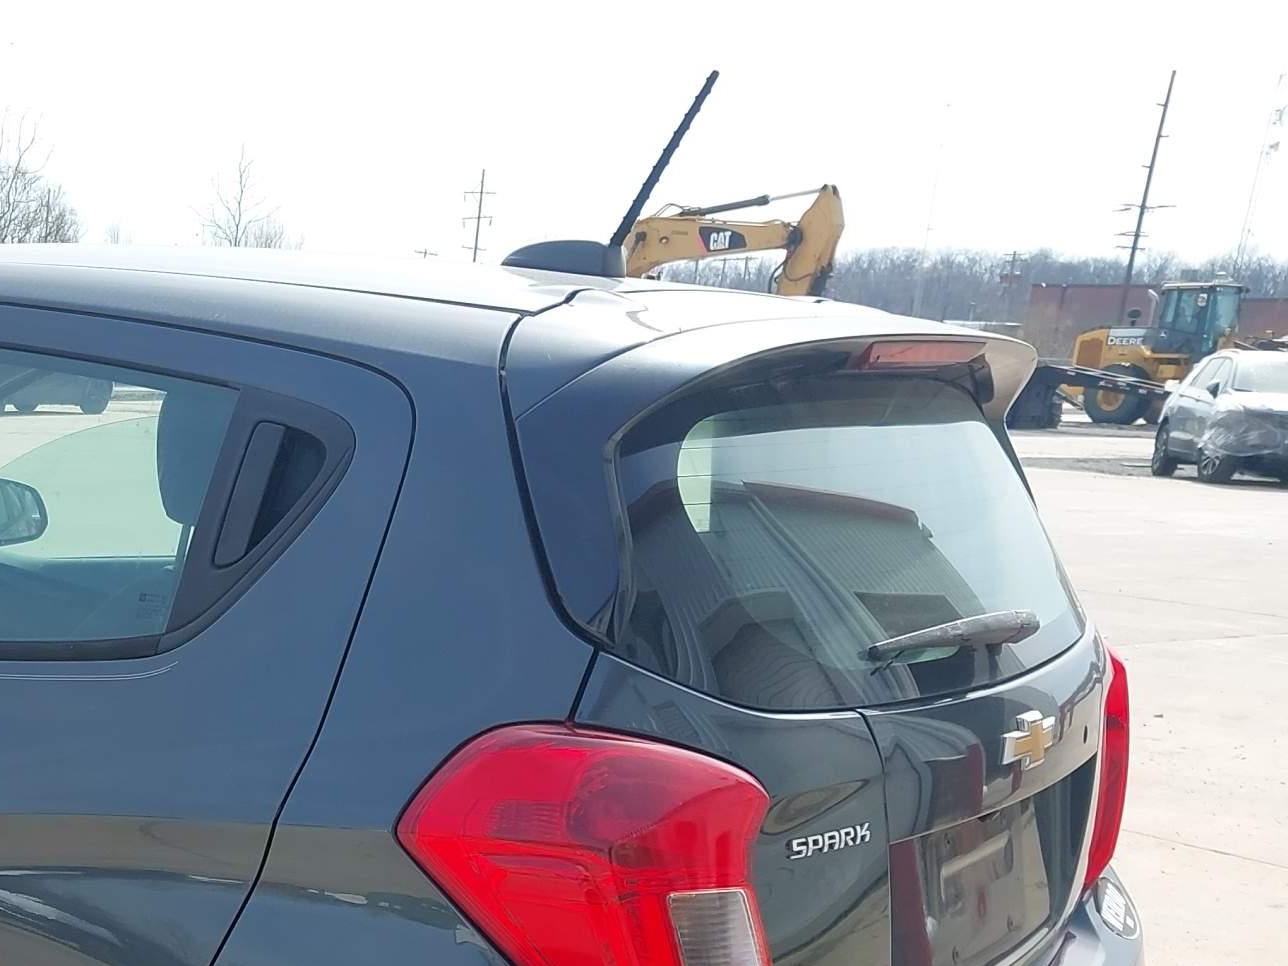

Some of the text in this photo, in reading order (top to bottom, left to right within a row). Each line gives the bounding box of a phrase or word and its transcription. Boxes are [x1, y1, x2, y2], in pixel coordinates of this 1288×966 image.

[710, 231, 732, 251] CAT
[1107, 336, 1144, 345] DEERE
[789, 822, 871, 860] SPARK
